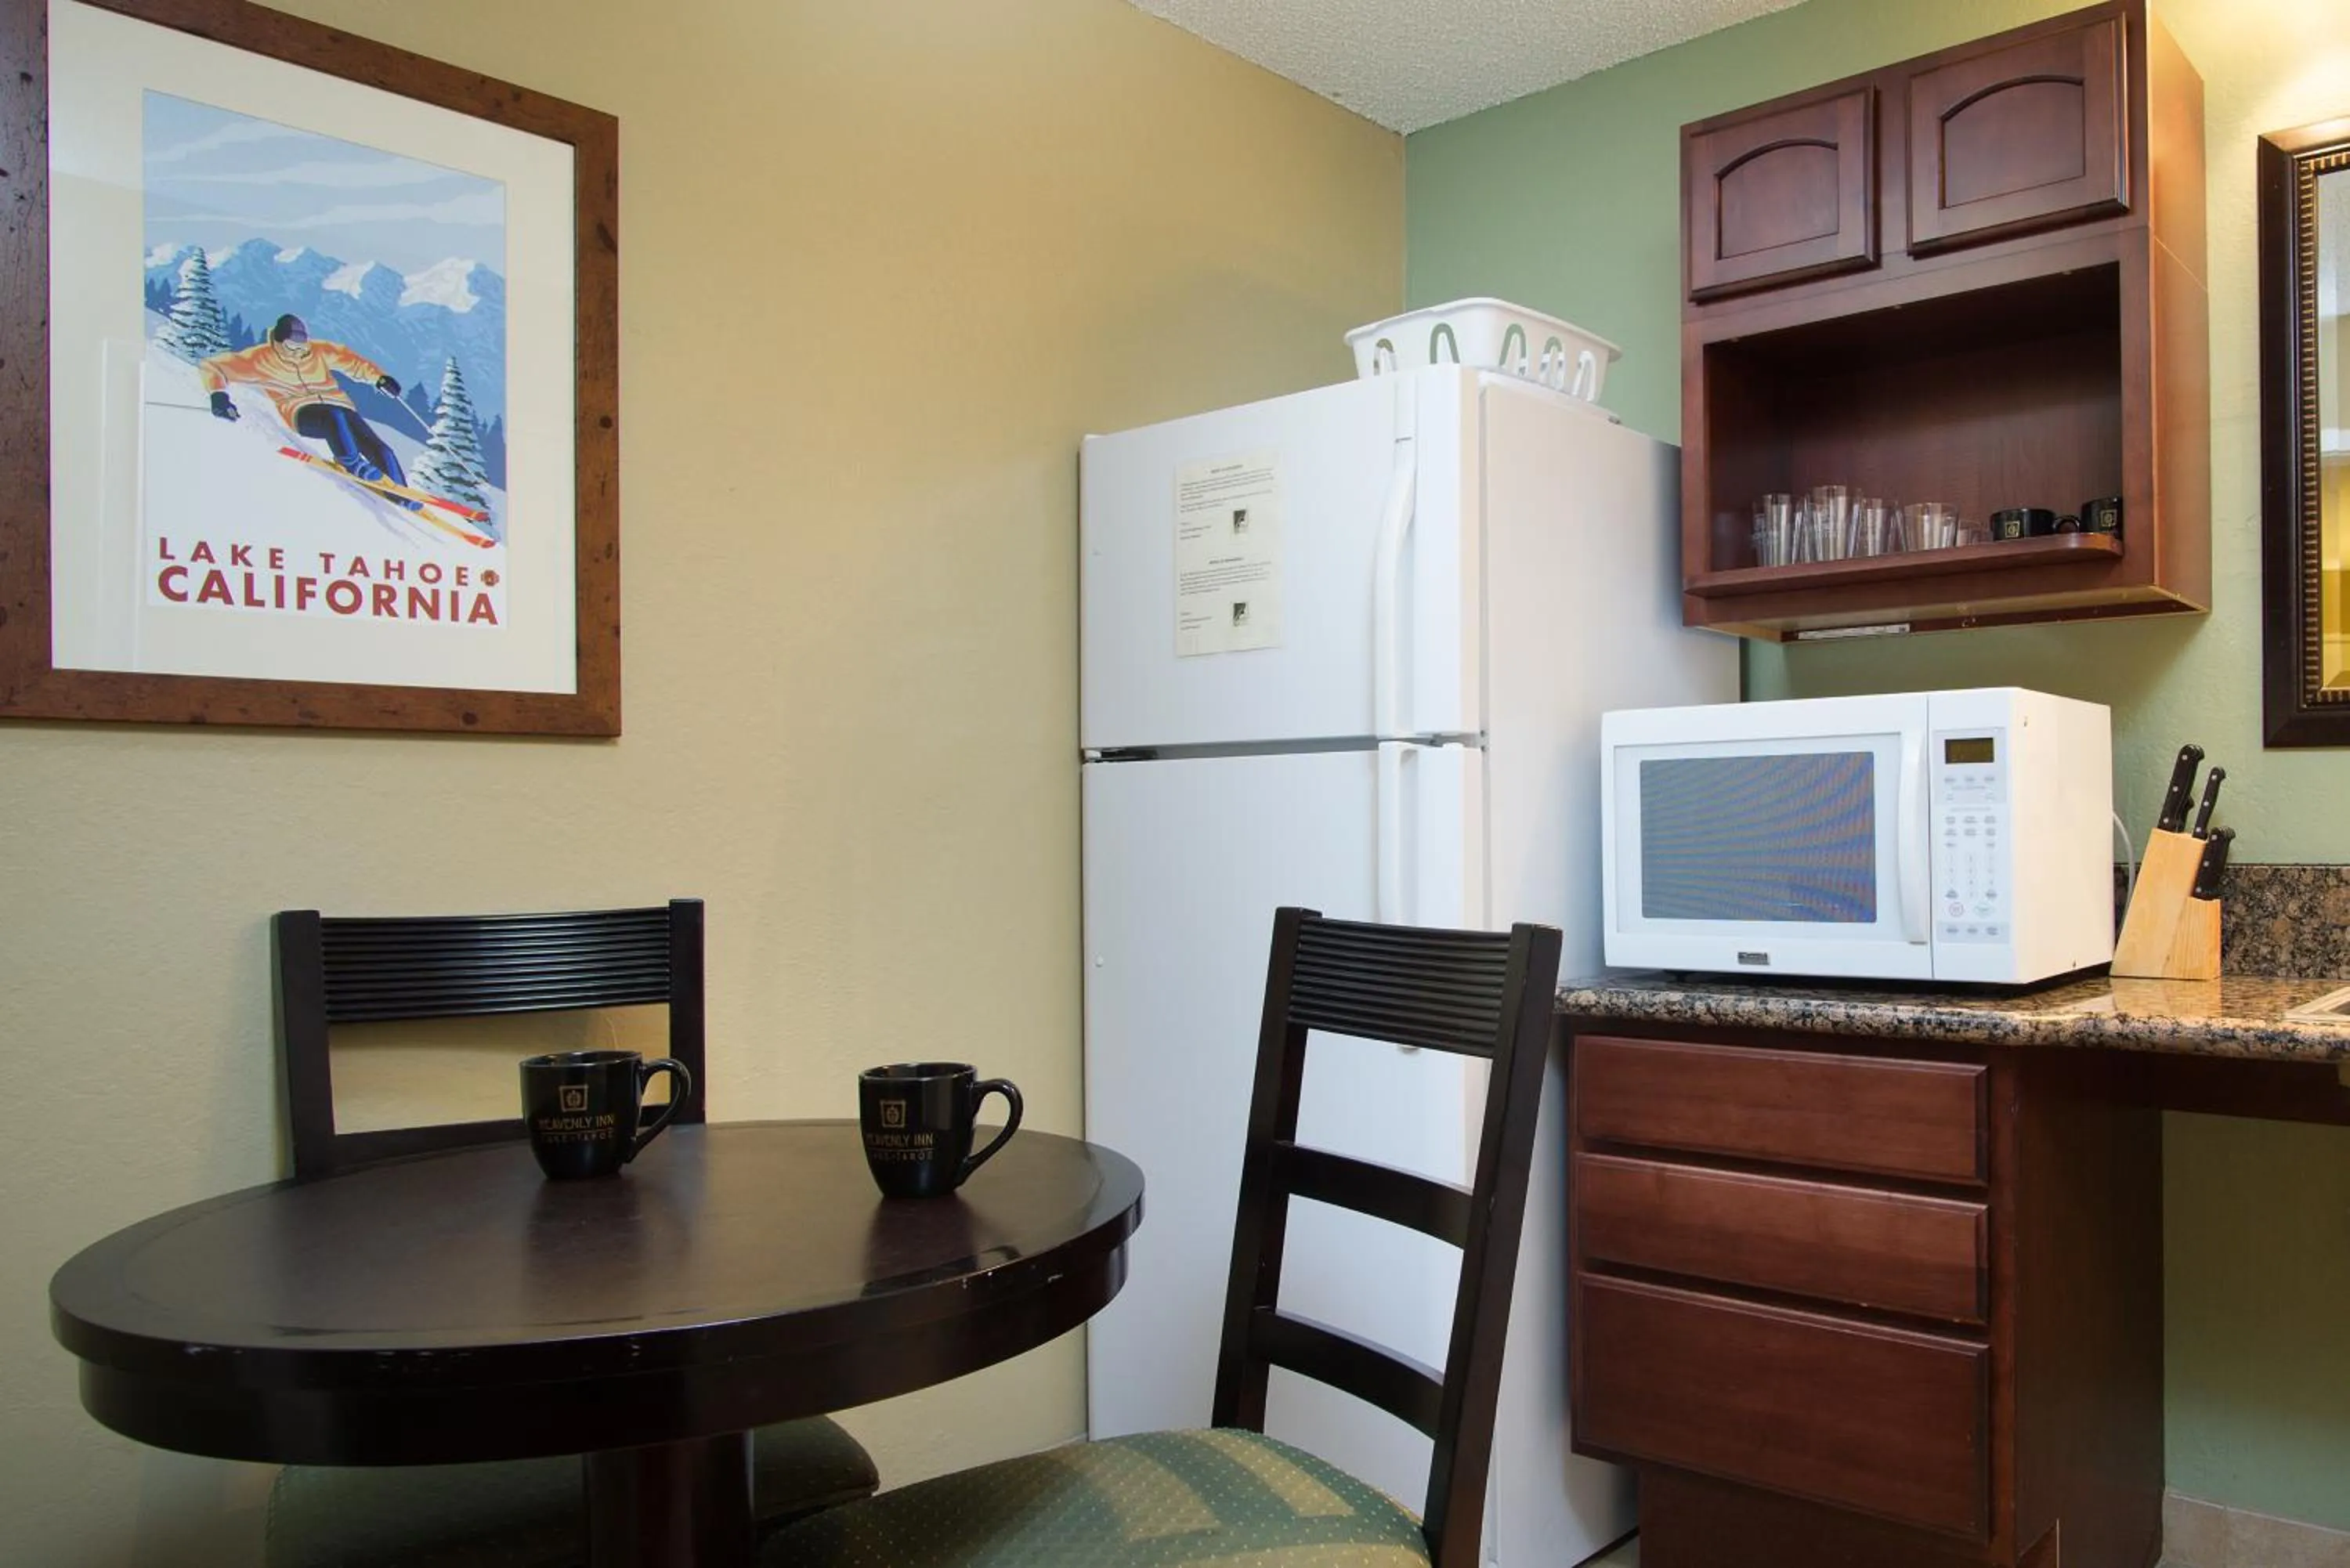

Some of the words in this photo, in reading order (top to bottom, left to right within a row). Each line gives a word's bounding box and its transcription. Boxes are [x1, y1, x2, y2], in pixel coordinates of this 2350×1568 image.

[159, 537, 284, 569] LAKE
[319, 552, 468, 587] TAHOE
[157, 565, 499, 625] CALIFORNIA
[596, 1115, 614, 1128] INN
[913, 1132, 933, 1147] INN
